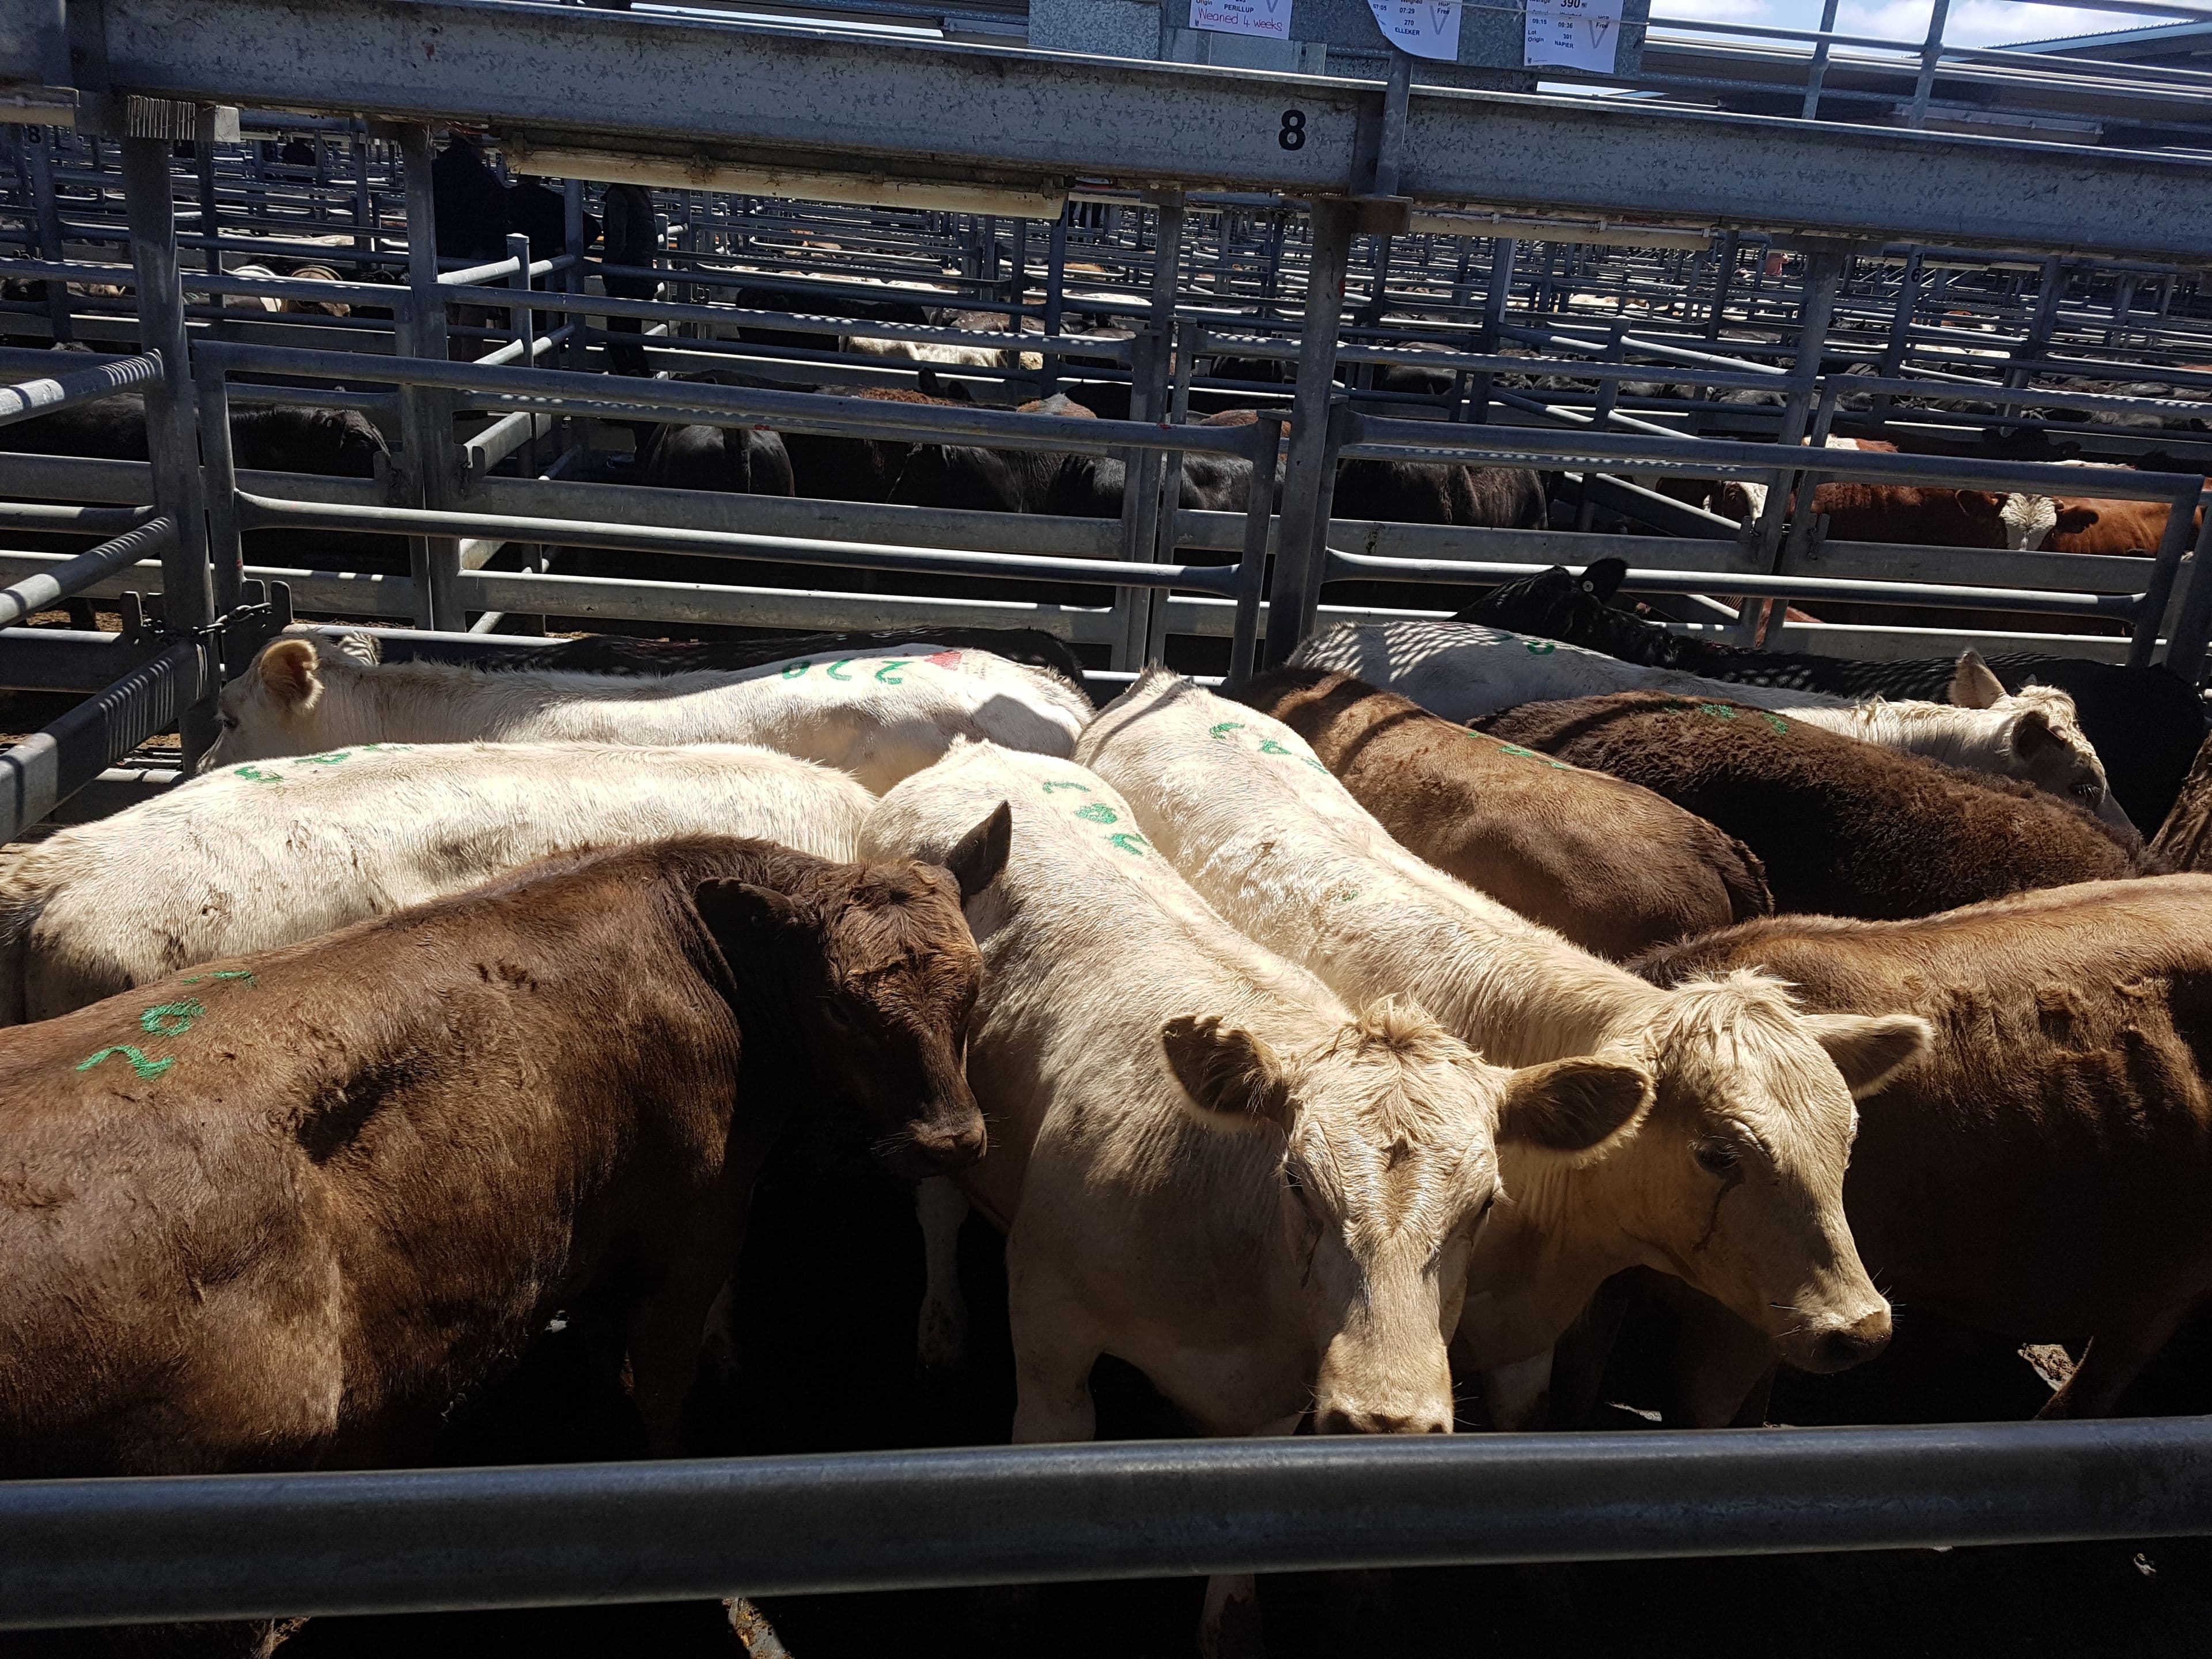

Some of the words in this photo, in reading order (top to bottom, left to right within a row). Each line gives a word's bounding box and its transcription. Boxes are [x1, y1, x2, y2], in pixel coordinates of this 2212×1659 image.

[1224, 4, 1253, 13] PERILLUP
[1560, 0, 1580, 8] 390
[1198, 7, 1238, 24] Weaned
[1244, 15, 1250, 28] 4
[1253, 18, 1282, 32] weeks
[1395, 27, 1420, 36] ELLEKER
[28, 126, 41, 143] 8
[1279, 109, 1306, 151] 8
